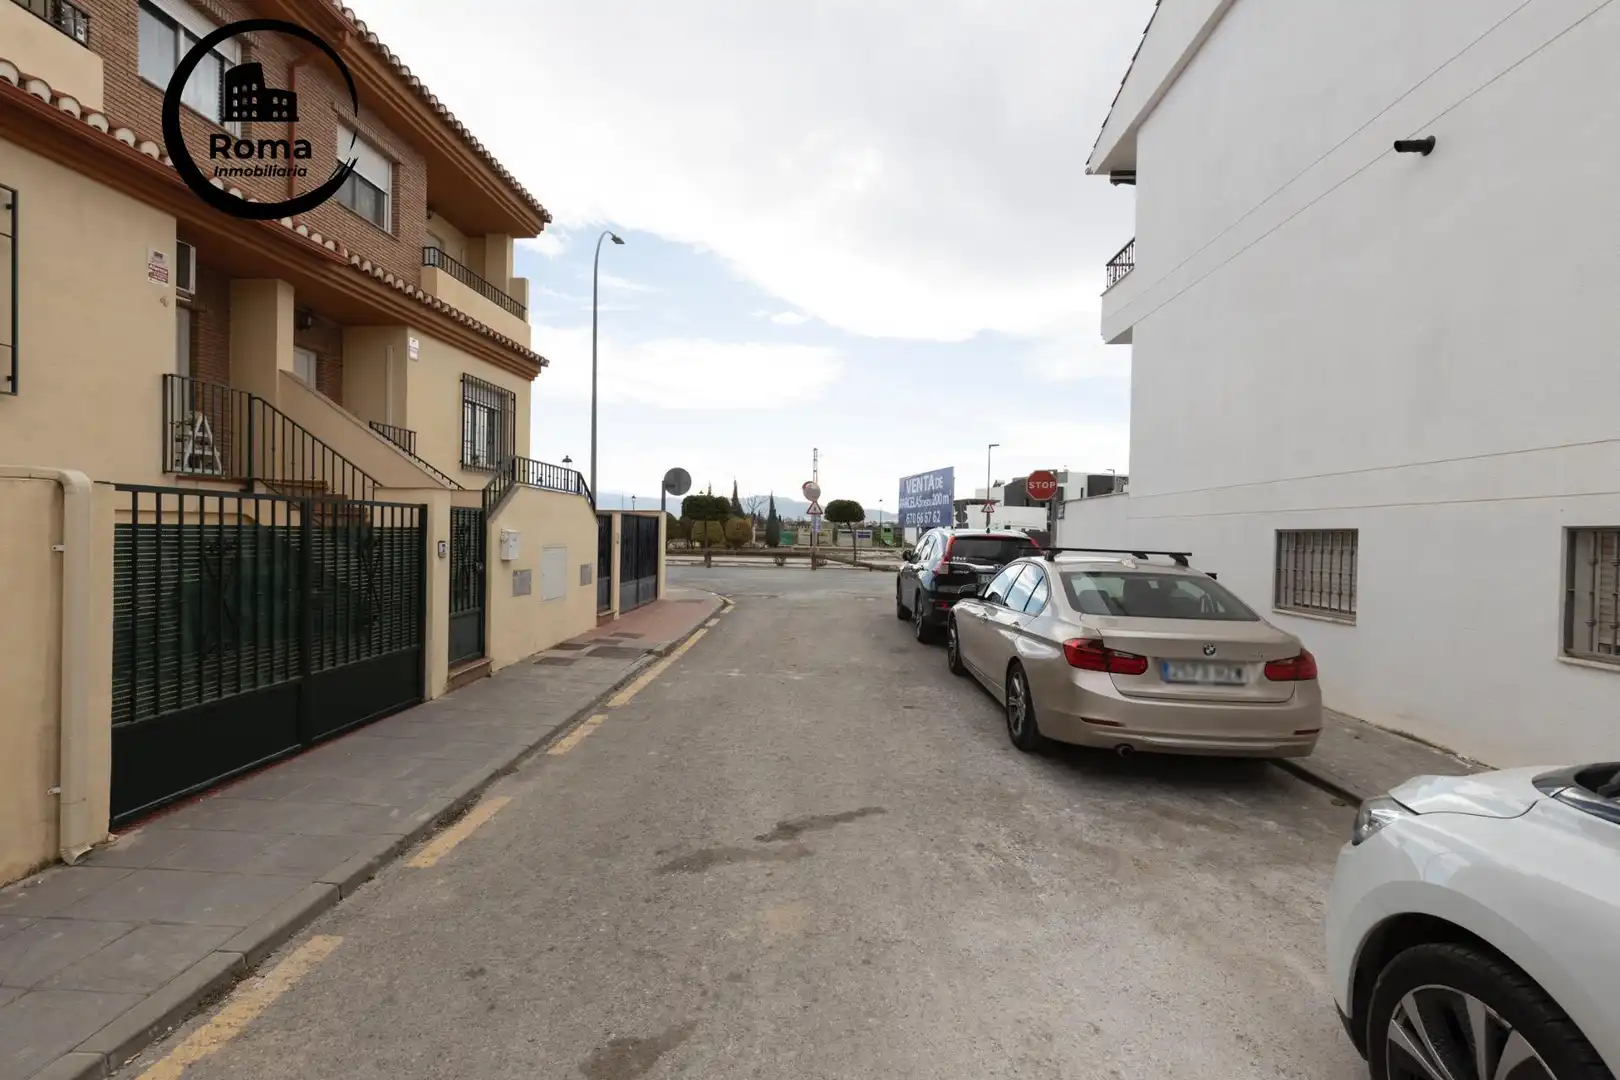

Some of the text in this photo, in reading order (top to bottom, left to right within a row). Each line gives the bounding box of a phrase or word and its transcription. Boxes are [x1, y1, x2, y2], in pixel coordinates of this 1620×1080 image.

[906, 474, 944, 494] VENTA DE
[1028, 481, 1056, 489] STOP
